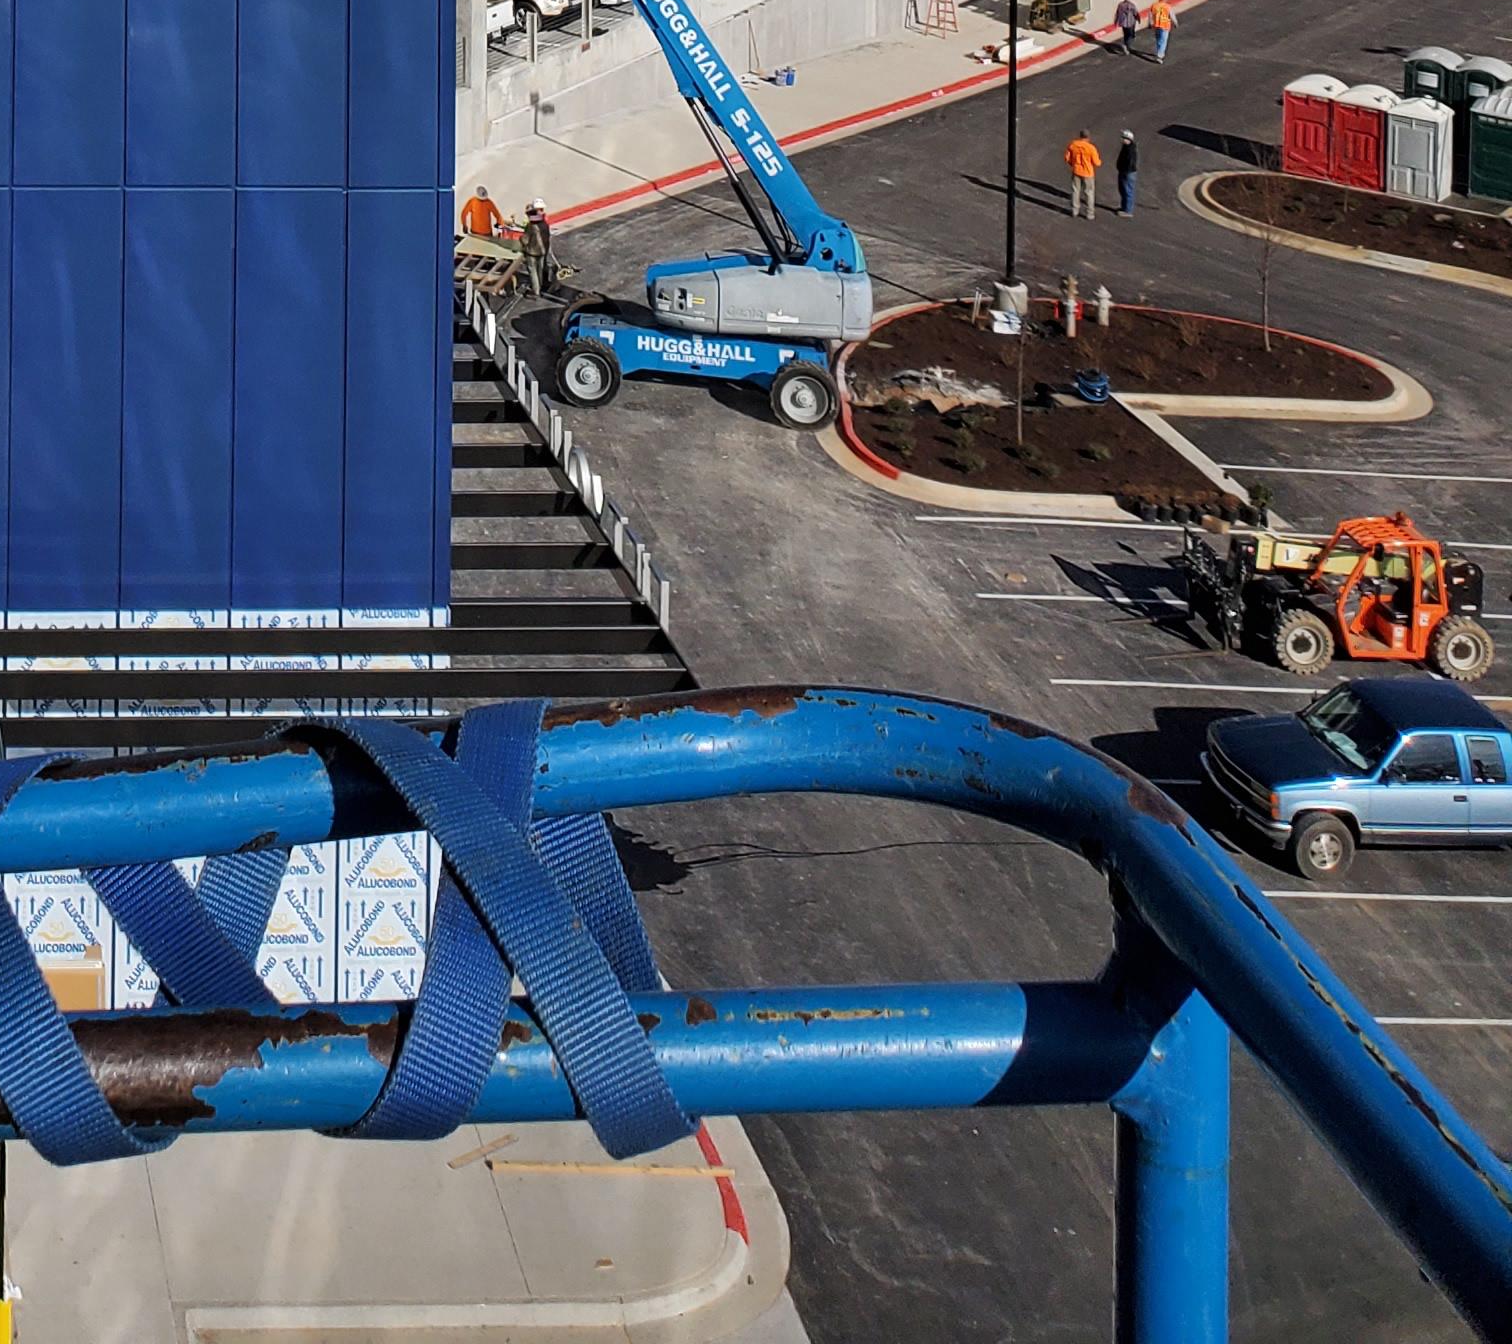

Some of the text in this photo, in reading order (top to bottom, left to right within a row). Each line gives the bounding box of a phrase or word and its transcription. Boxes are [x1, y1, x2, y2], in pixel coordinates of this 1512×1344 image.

[730, 108, 783, 177] S-125
[637, 335, 756, 362] HUGG&HALL
[662, 352, 726, 368] EQUIPMENT
[357, 878, 418, 889] ALUCOBOND
[24, 896, 55, 939] COBOND
[61, 897, 102, 947] ALUCOBON
[284, 889, 325, 944] ALUCOBOND
[344, 900, 386, 957] ALUCOBOND
[34, 942, 87, 954] LUCOBOND
[263, 933, 309, 945] UCOBOND
[357, 945, 417, 957] ALUCOBOND
